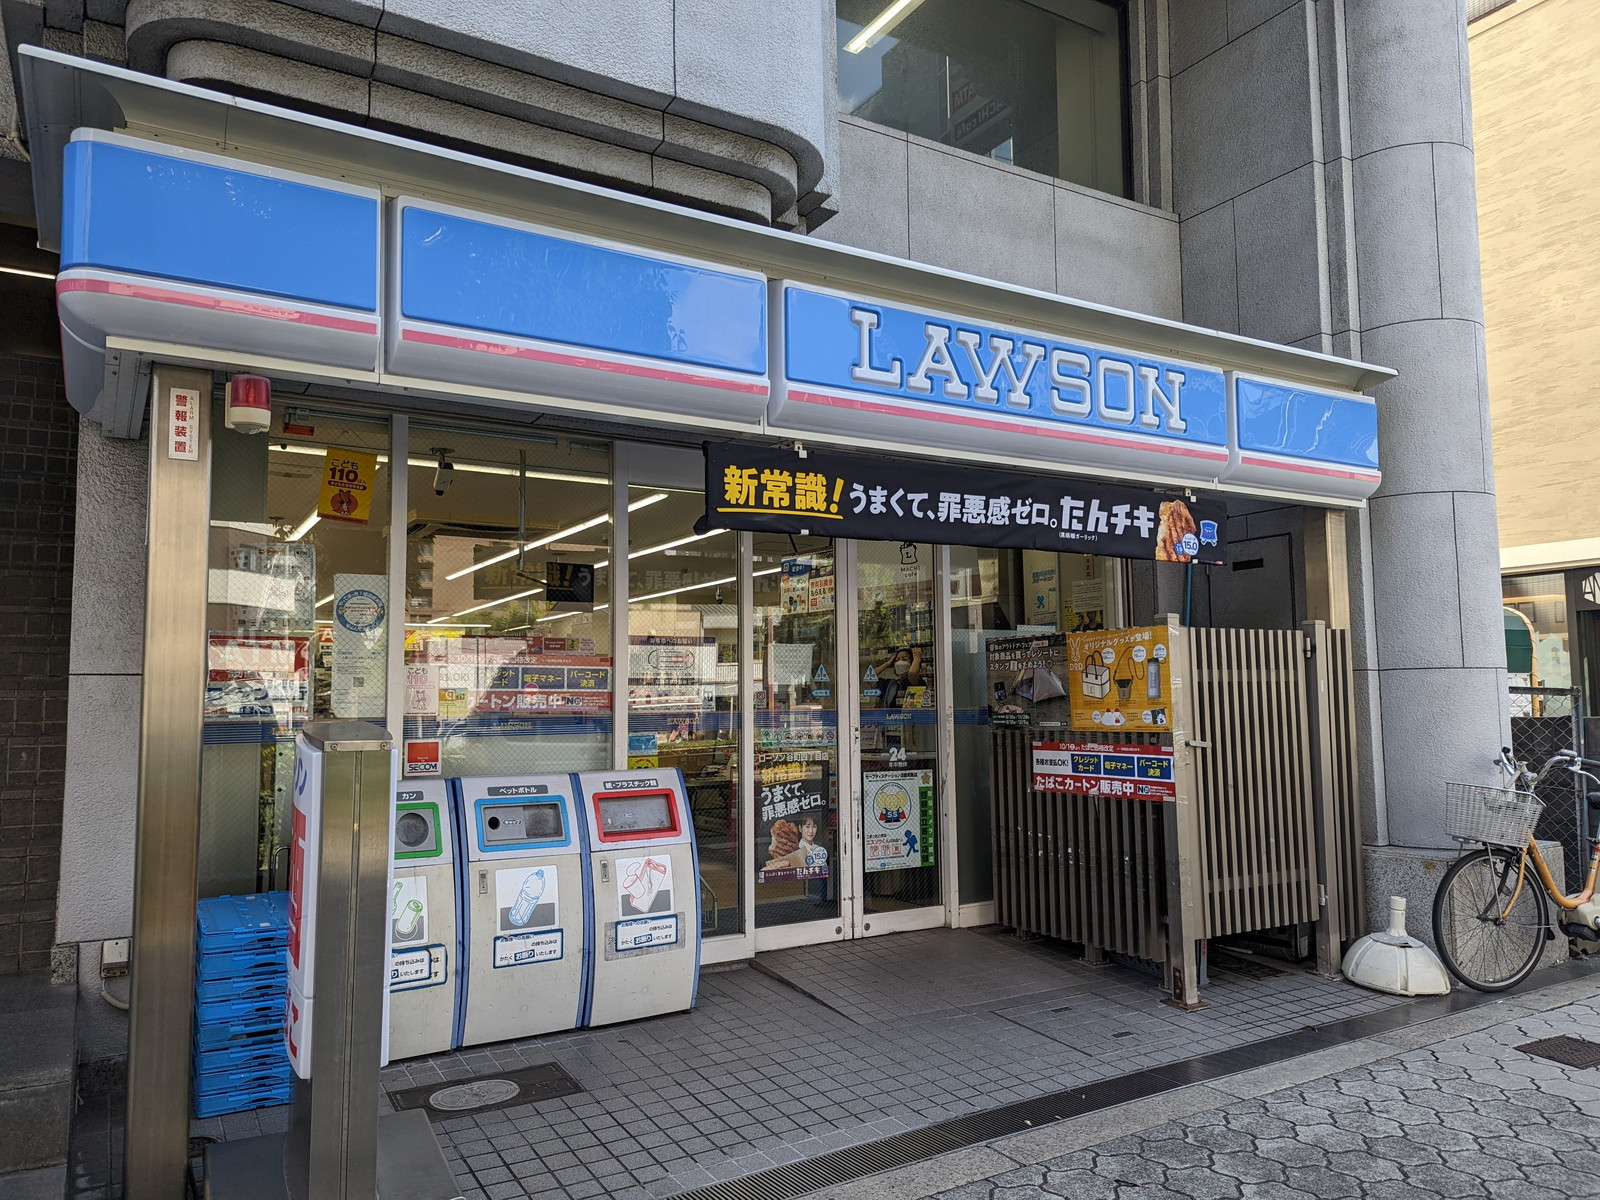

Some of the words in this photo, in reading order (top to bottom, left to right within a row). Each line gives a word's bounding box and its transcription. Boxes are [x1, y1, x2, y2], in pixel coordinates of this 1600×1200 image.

[849, 305, 1187, 434] LAWSON
[174, 394, 188, 453] 警報装置
[331, 458, 359, 471] こども
[329, 466, 359, 483] 110
[723, 464, 844, 514] 新常識!
[1059, 495, 1155, 539] たんチキ
[1183, 540, 1198, 551] 15.0
[900, 565, 921, 573] MACHI
[407, 667, 429, 675] こども
[569, 671, 605, 679] バーコード
[407, 674, 428, 685] 110
[523, 674, 563, 683] 電子マネー
[580, 679, 596, 688] 決済
[758, 754, 786, 763] ローソン
[786, 752, 830, 762] 谷町四丁目店
[889, 747, 907, 762] 24
[1073, 755, 1099, 764] クレジット
[1139, 758, 1169, 768] バーコード
[408, 763, 438, 772] SECOM
[1078, 764, 1095, 772] カード
[1104, 761, 1134, 771] 電子マネー
[1147, 768, 1161, 777] 決済
[605, 780, 658, 789] 紙・プラスチック類
[1035, 775, 1135, 797] たばこカートン販売中
[499, 786, 538, 795] ペットボトル
[761, 782, 805, 806] うまくて、
[401, 792, 417, 800] カン
[761, 793, 827, 822] 罪悪感ゼロ。
[813, 851, 827, 860] 15.0
[796, 865, 821, 876] たんチキ
[621, 919, 652, 928] お客様へのお願い
[648, 924, 673, 932] の持ち込みは
[500, 933, 535, 943] お客様へのお願い
[653, 933, 673, 941] いたします
[531, 939, 558, 947] の持ち込みは
[535, 949, 557, 957] いたします
[394, 957, 425, 967] の持ち込みは
[400, 968, 424, 977] いたします
